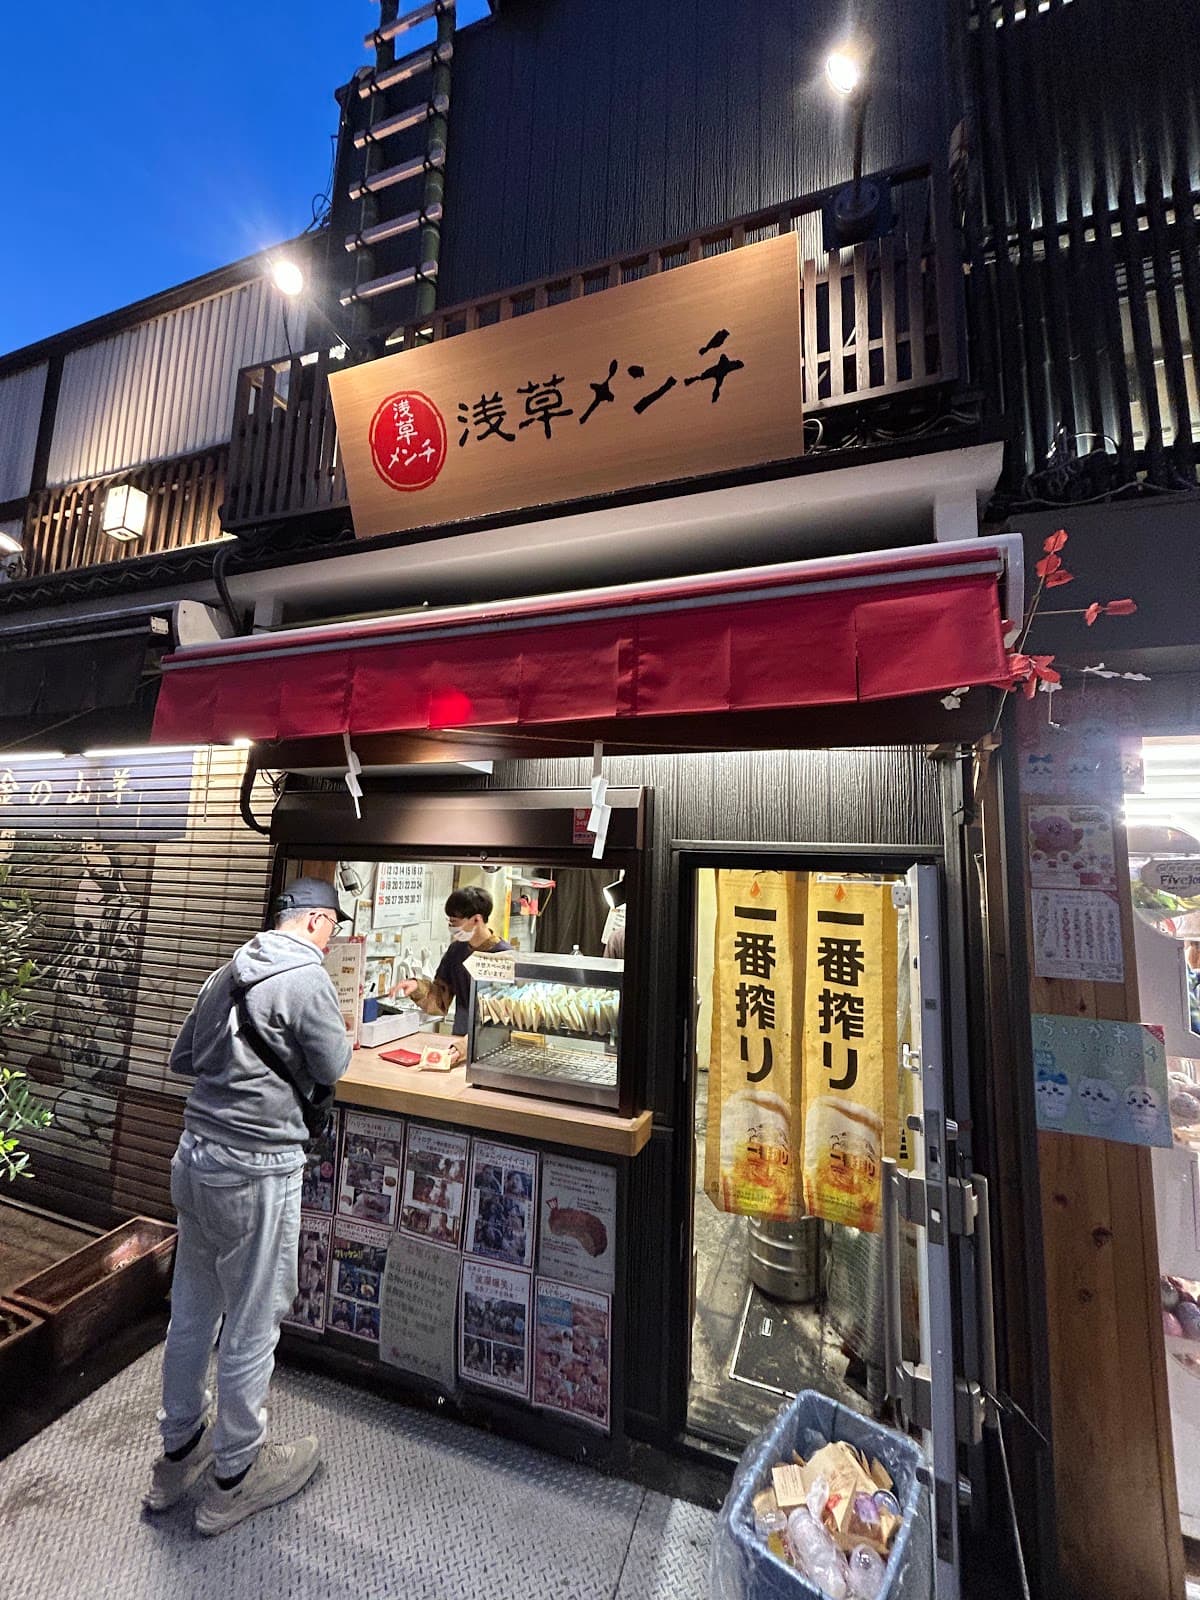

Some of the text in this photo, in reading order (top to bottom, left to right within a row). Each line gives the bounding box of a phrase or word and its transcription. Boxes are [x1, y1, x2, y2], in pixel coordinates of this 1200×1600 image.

[392, 398, 419, 443] 浅草
[456, 329, 745, 447] 浅草メンチ
[388, 437, 435, 469] メンチ
[734, 905, 777, 1083] 一番搾り
[817, 910, 865, 1090] 一番搾り
